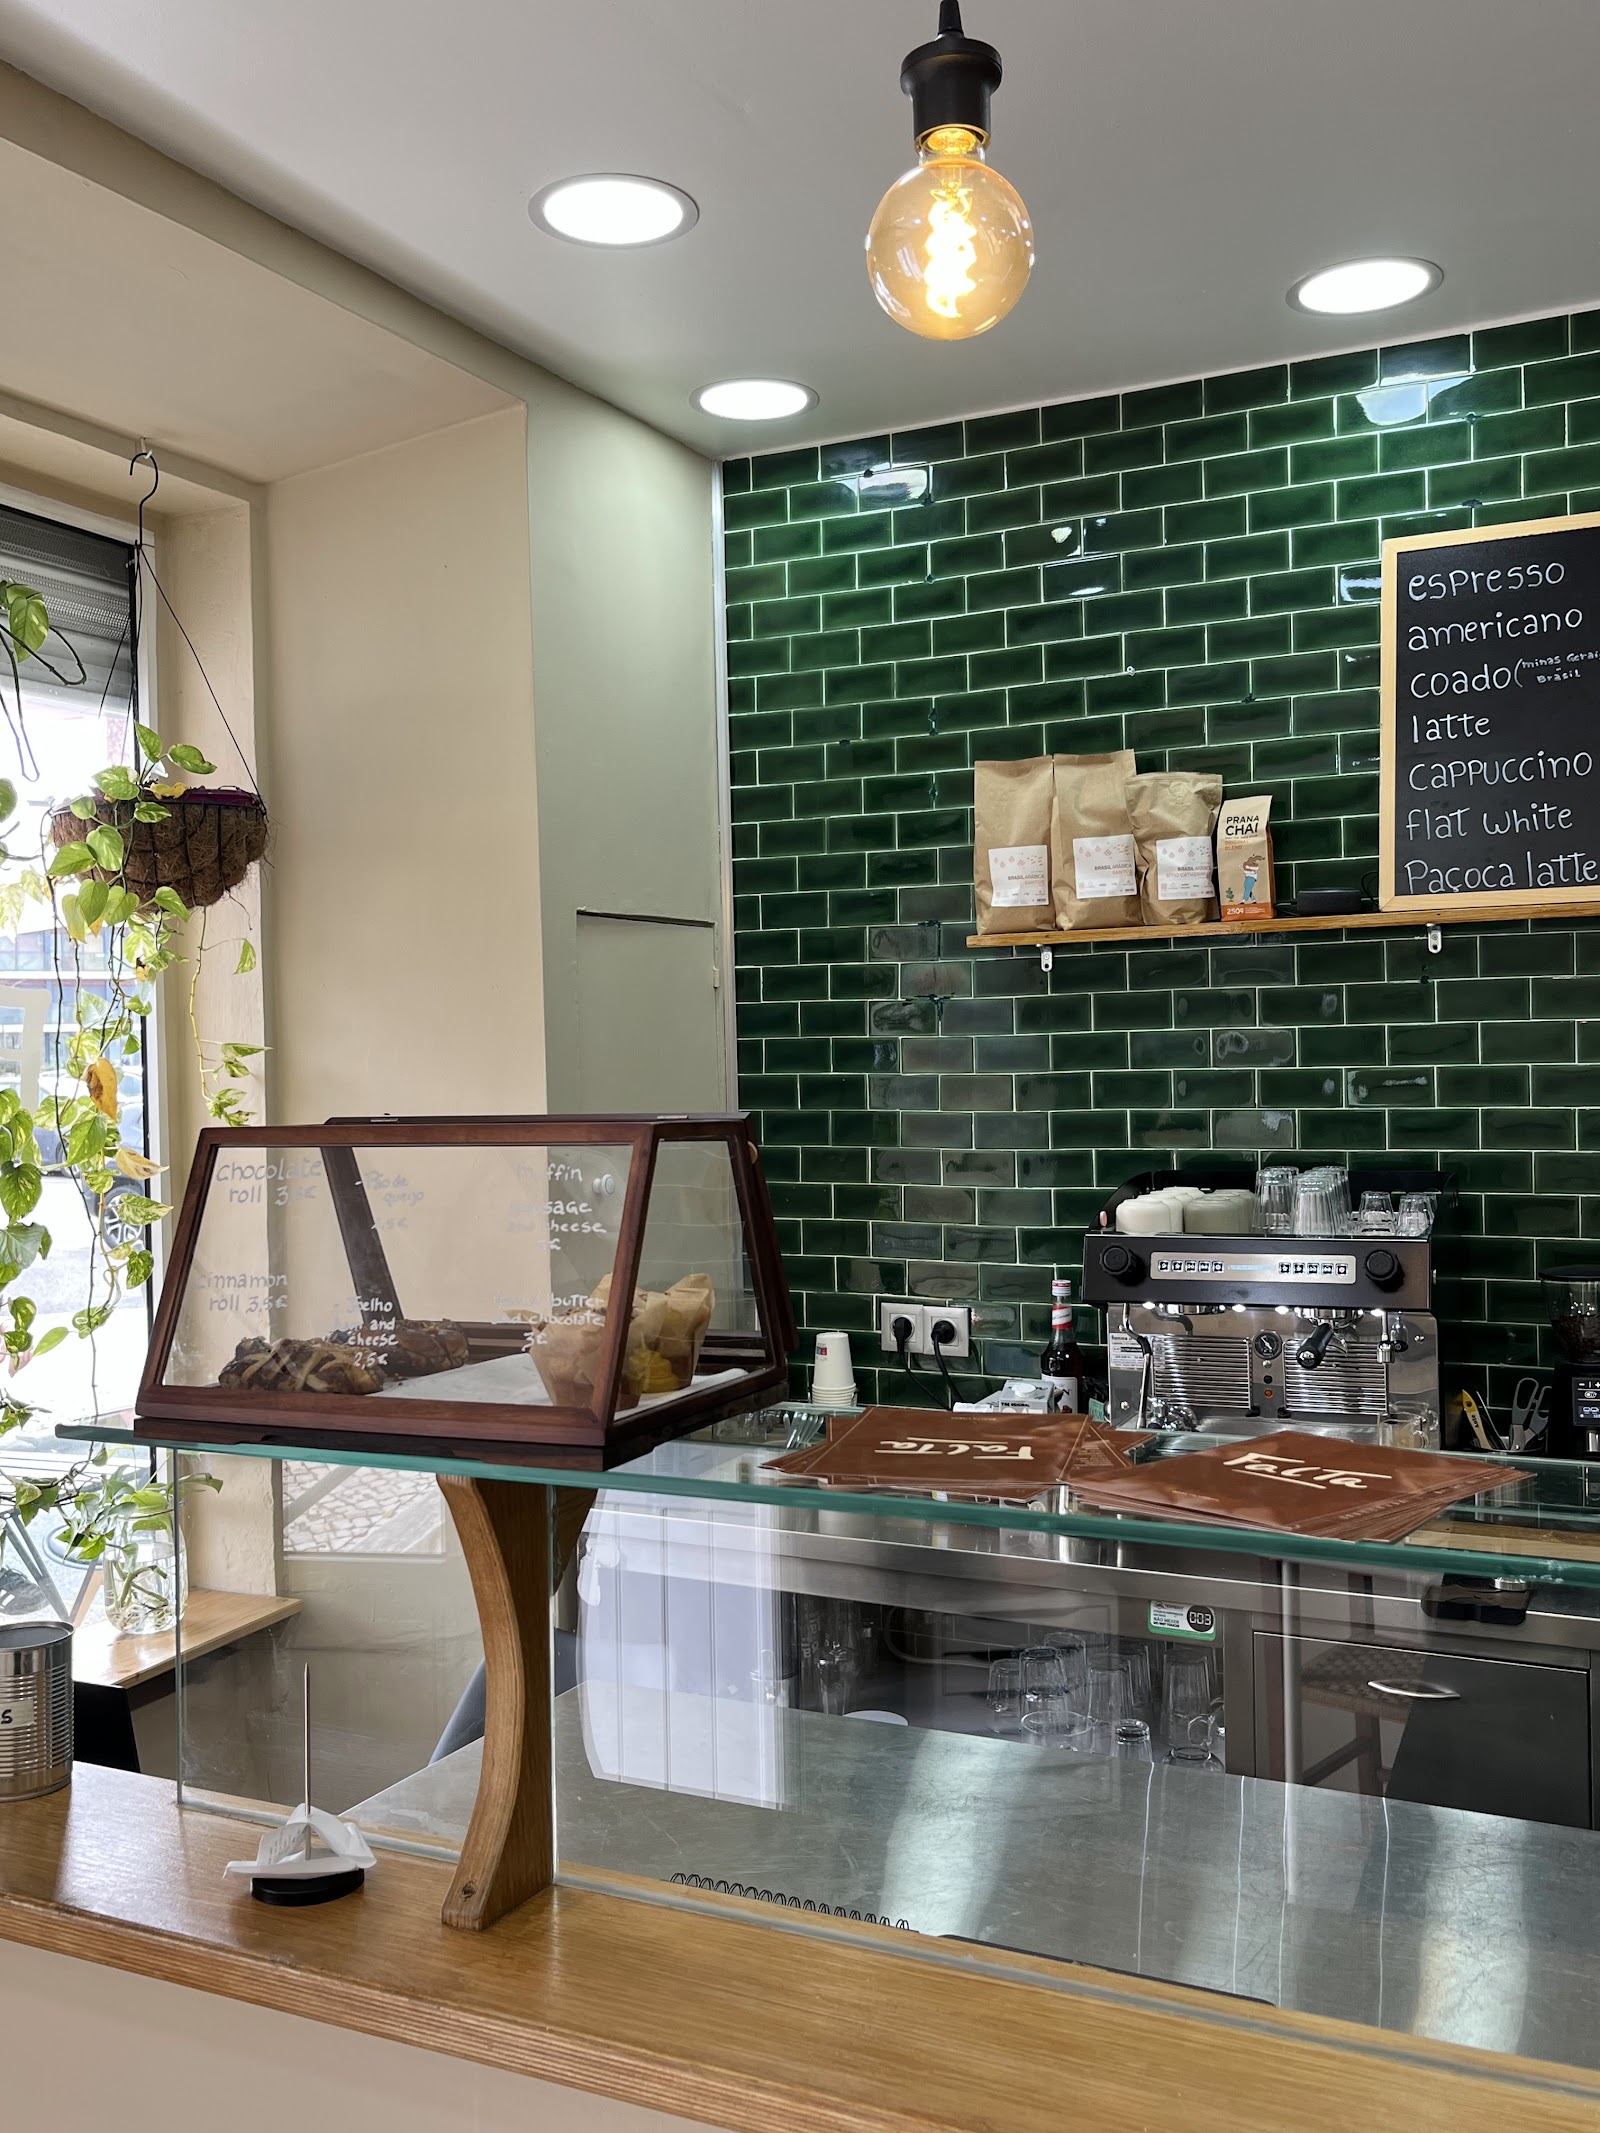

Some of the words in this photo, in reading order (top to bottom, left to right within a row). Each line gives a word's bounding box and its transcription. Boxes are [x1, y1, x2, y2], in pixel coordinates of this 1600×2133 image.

[1408, 562, 1566, 601] espresso
[1408, 608, 1583, 651] americano
[1566, 651, 1600, 662] Gerai
[1412, 713, 1491, 743] latte
[1226, 815, 1260, 824] PRANA
[1406, 807, 1471, 841] flat
[1482, 803, 1573, 835] white
[1225, 822, 1259, 836] CHAI
[1527, 851, 1599, 887] latte
[229, 1184, 262, 1203] roll
[209, 1294, 240, 1311] roll
[370, 1316, 397, 1331] and
[347, 1332, 399, 1347] cheese
